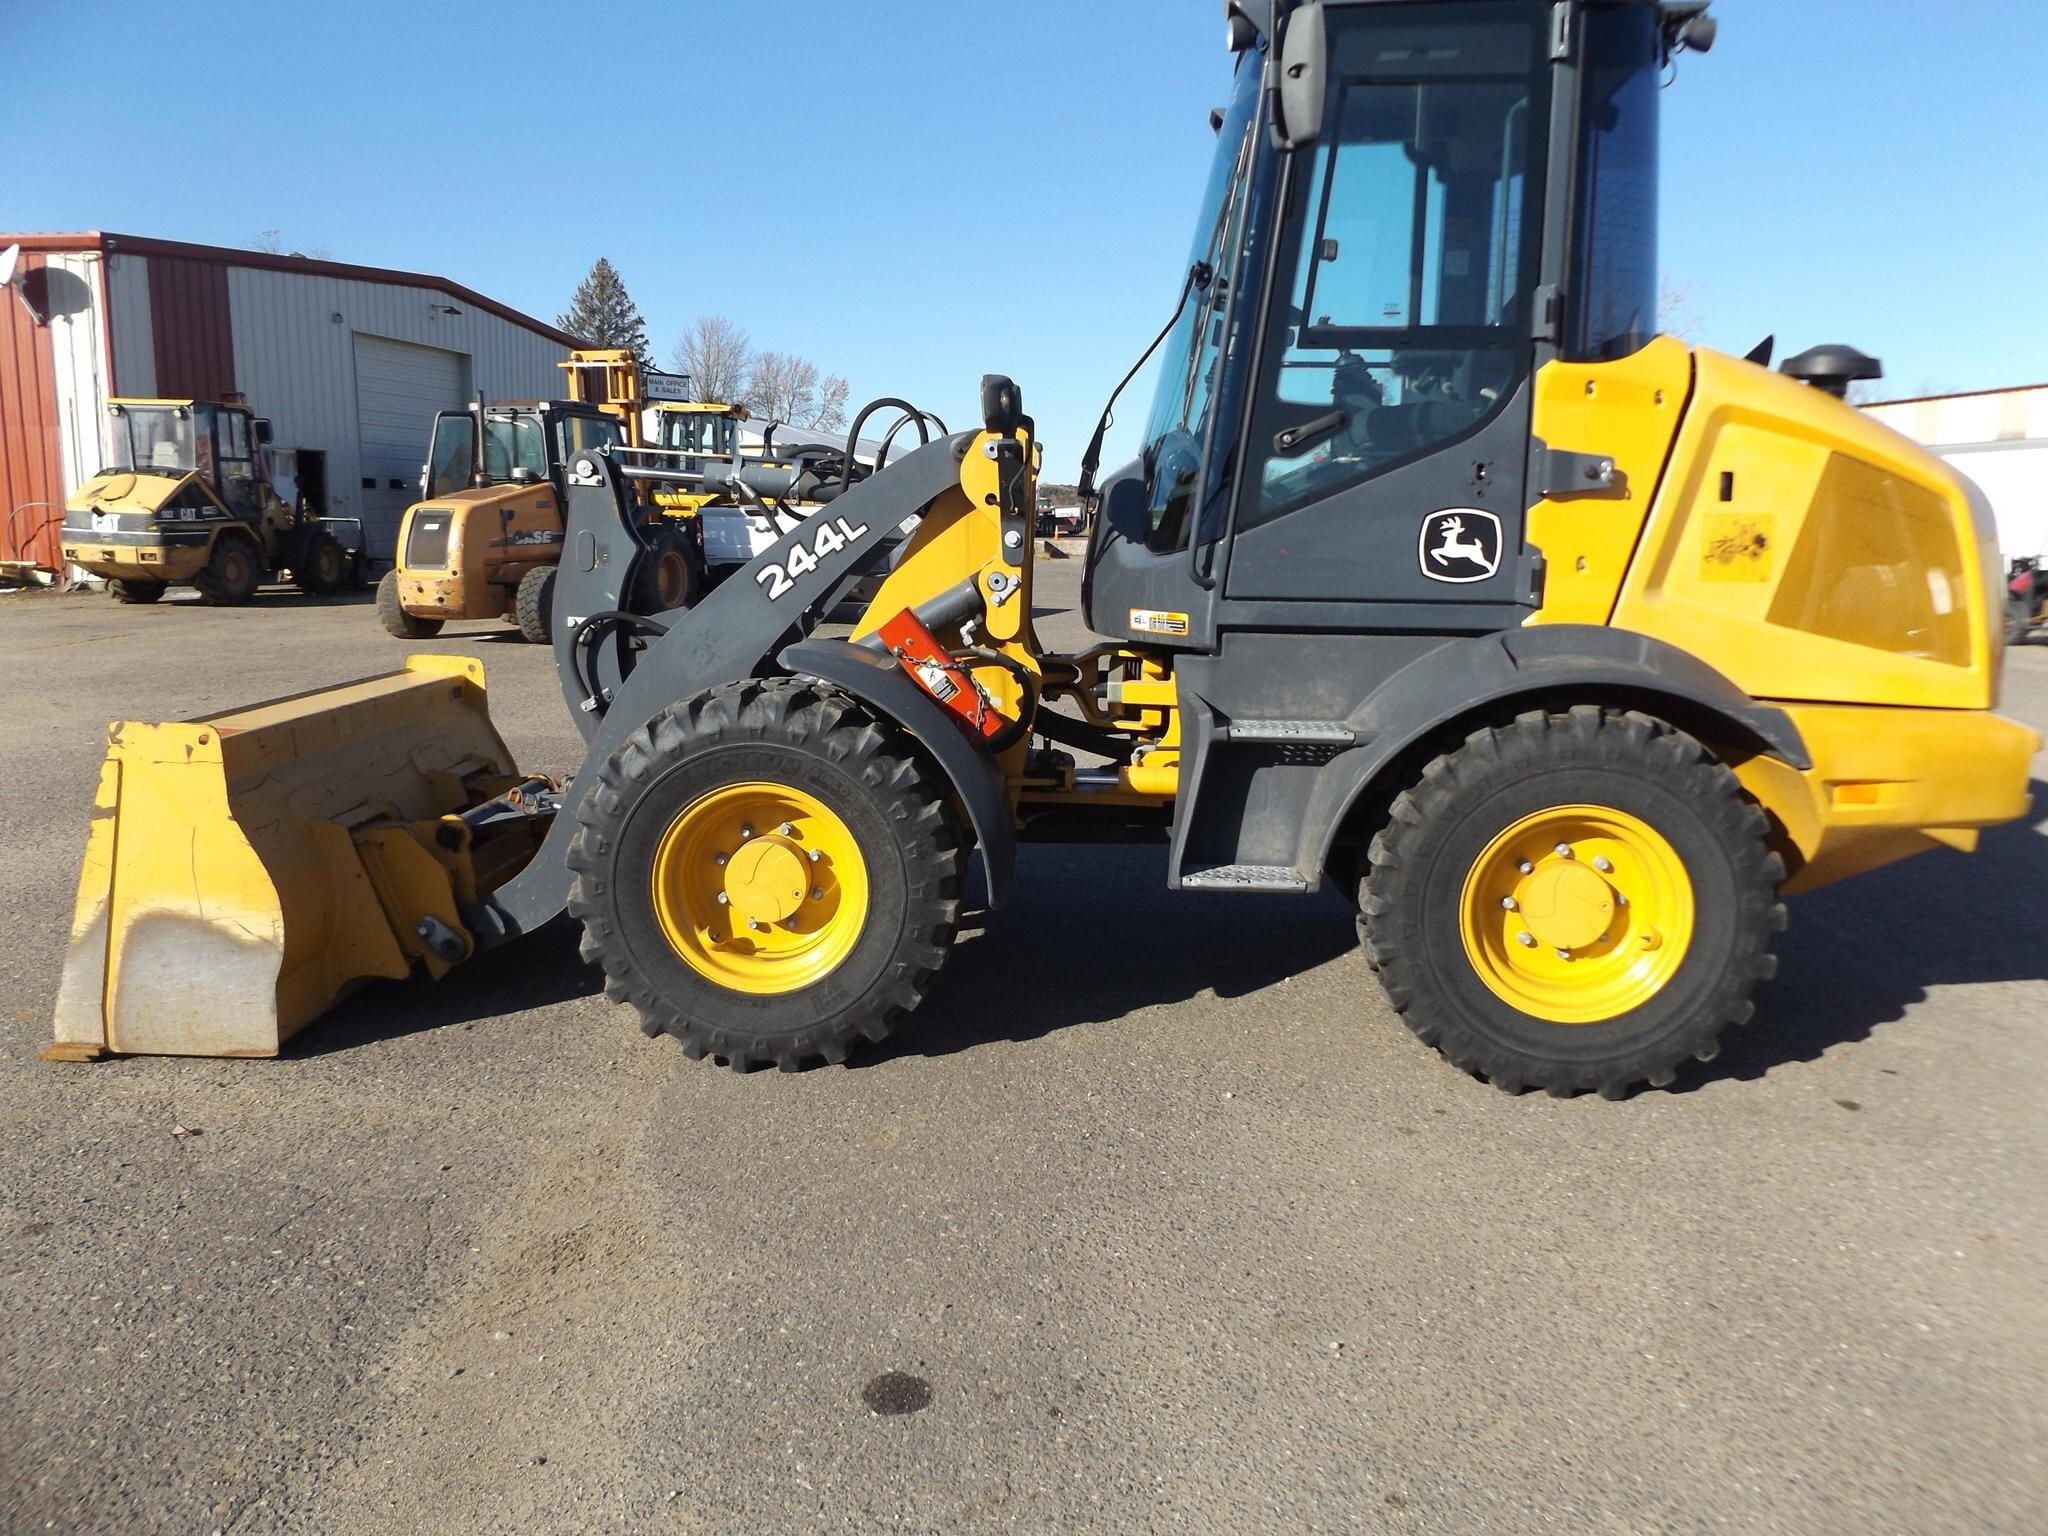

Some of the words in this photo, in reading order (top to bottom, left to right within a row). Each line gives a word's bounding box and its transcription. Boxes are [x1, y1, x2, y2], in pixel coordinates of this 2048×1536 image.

[662, 386, 681, 394] SALES
[666, 380, 688, 388] OFFICE
[180, 508, 196, 521] CAT
[92, 514, 120, 532] CAT
[754, 516, 869, 602] 244L
